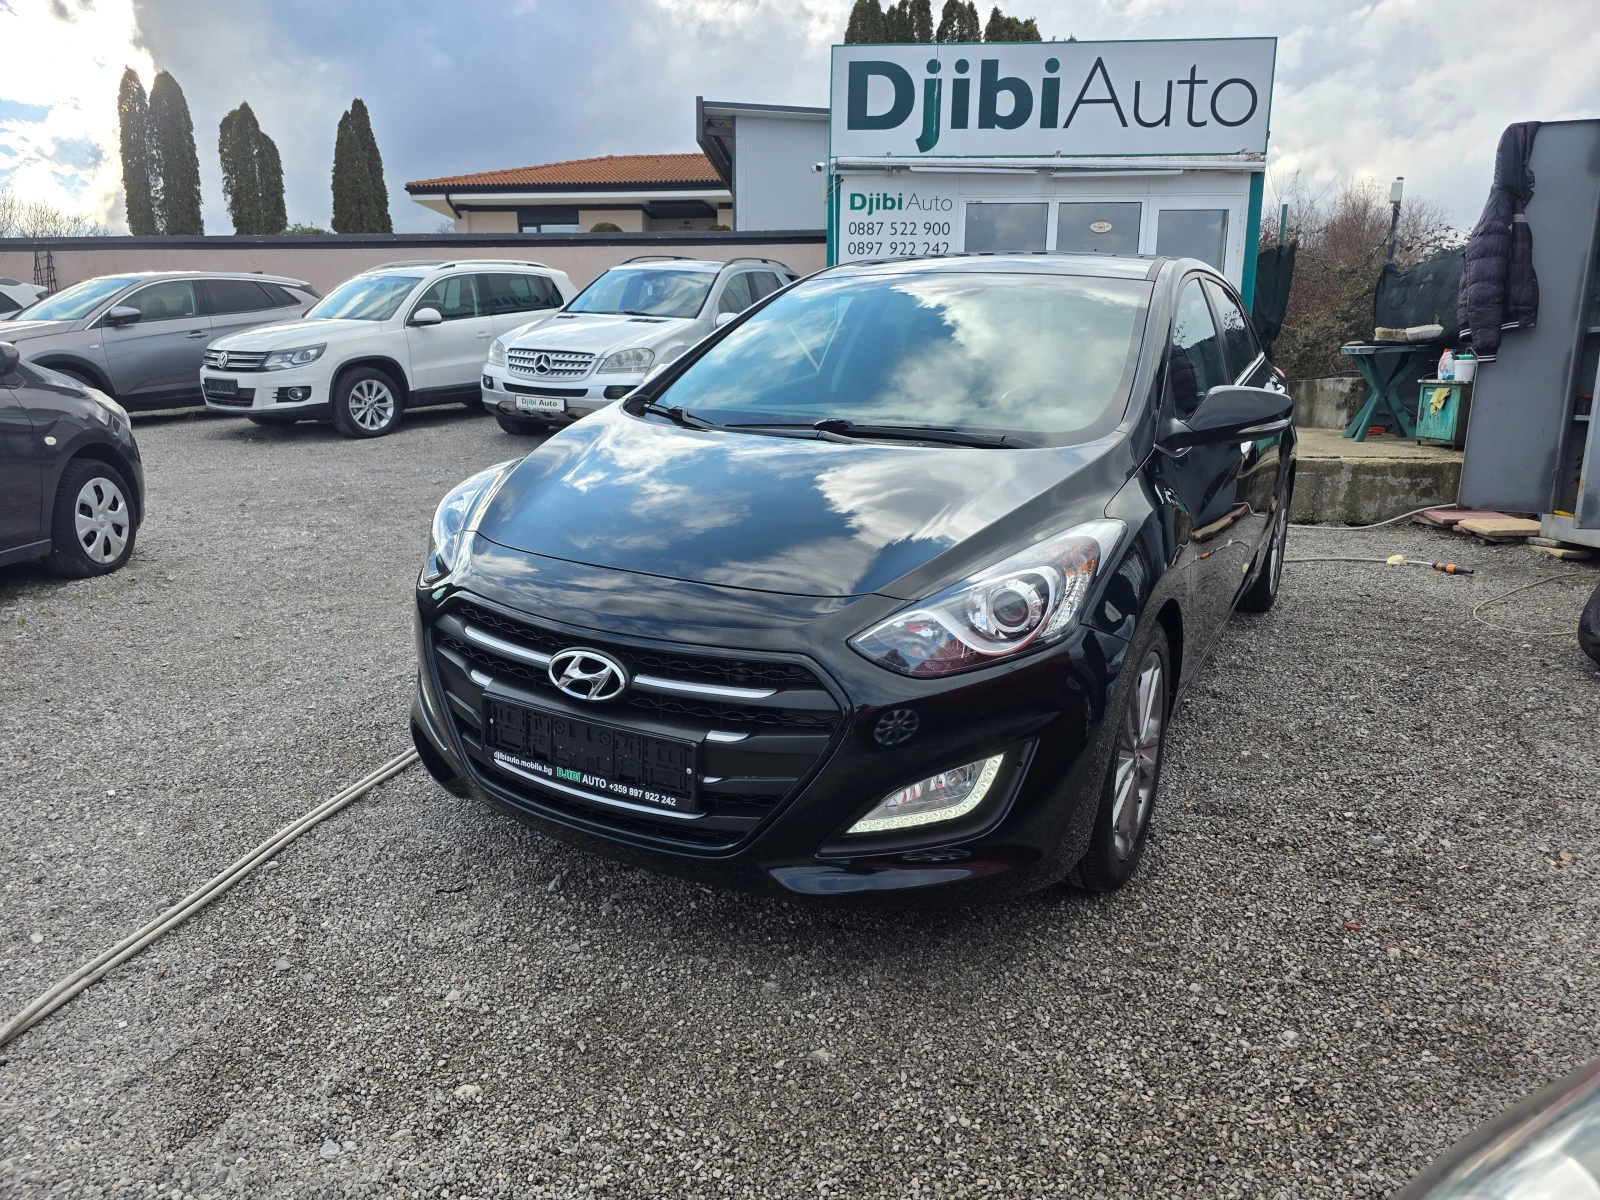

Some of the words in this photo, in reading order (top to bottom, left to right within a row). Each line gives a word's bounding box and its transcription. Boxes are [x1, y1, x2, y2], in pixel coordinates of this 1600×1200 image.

[849, 192, 903, 216] Djibi
[905, 192, 953, 211] Auto
[848, 221, 885, 236] 0887
[889, 221, 917, 236] 522
[923, 221, 951, 236] 900
[847, 241, 883, 256] 0897
[889, 241, 917, 256] 922
[922, 241, 949, 255] 242
[521, 398, 537, 406] Djibi
[581, 774, 607, 789] AUTO
[608, 783, 628, 794] +359
[628, 787, 643, 798] 897
[644, 791, 660, 802] 922
[660, 795, 677, 807] 242
